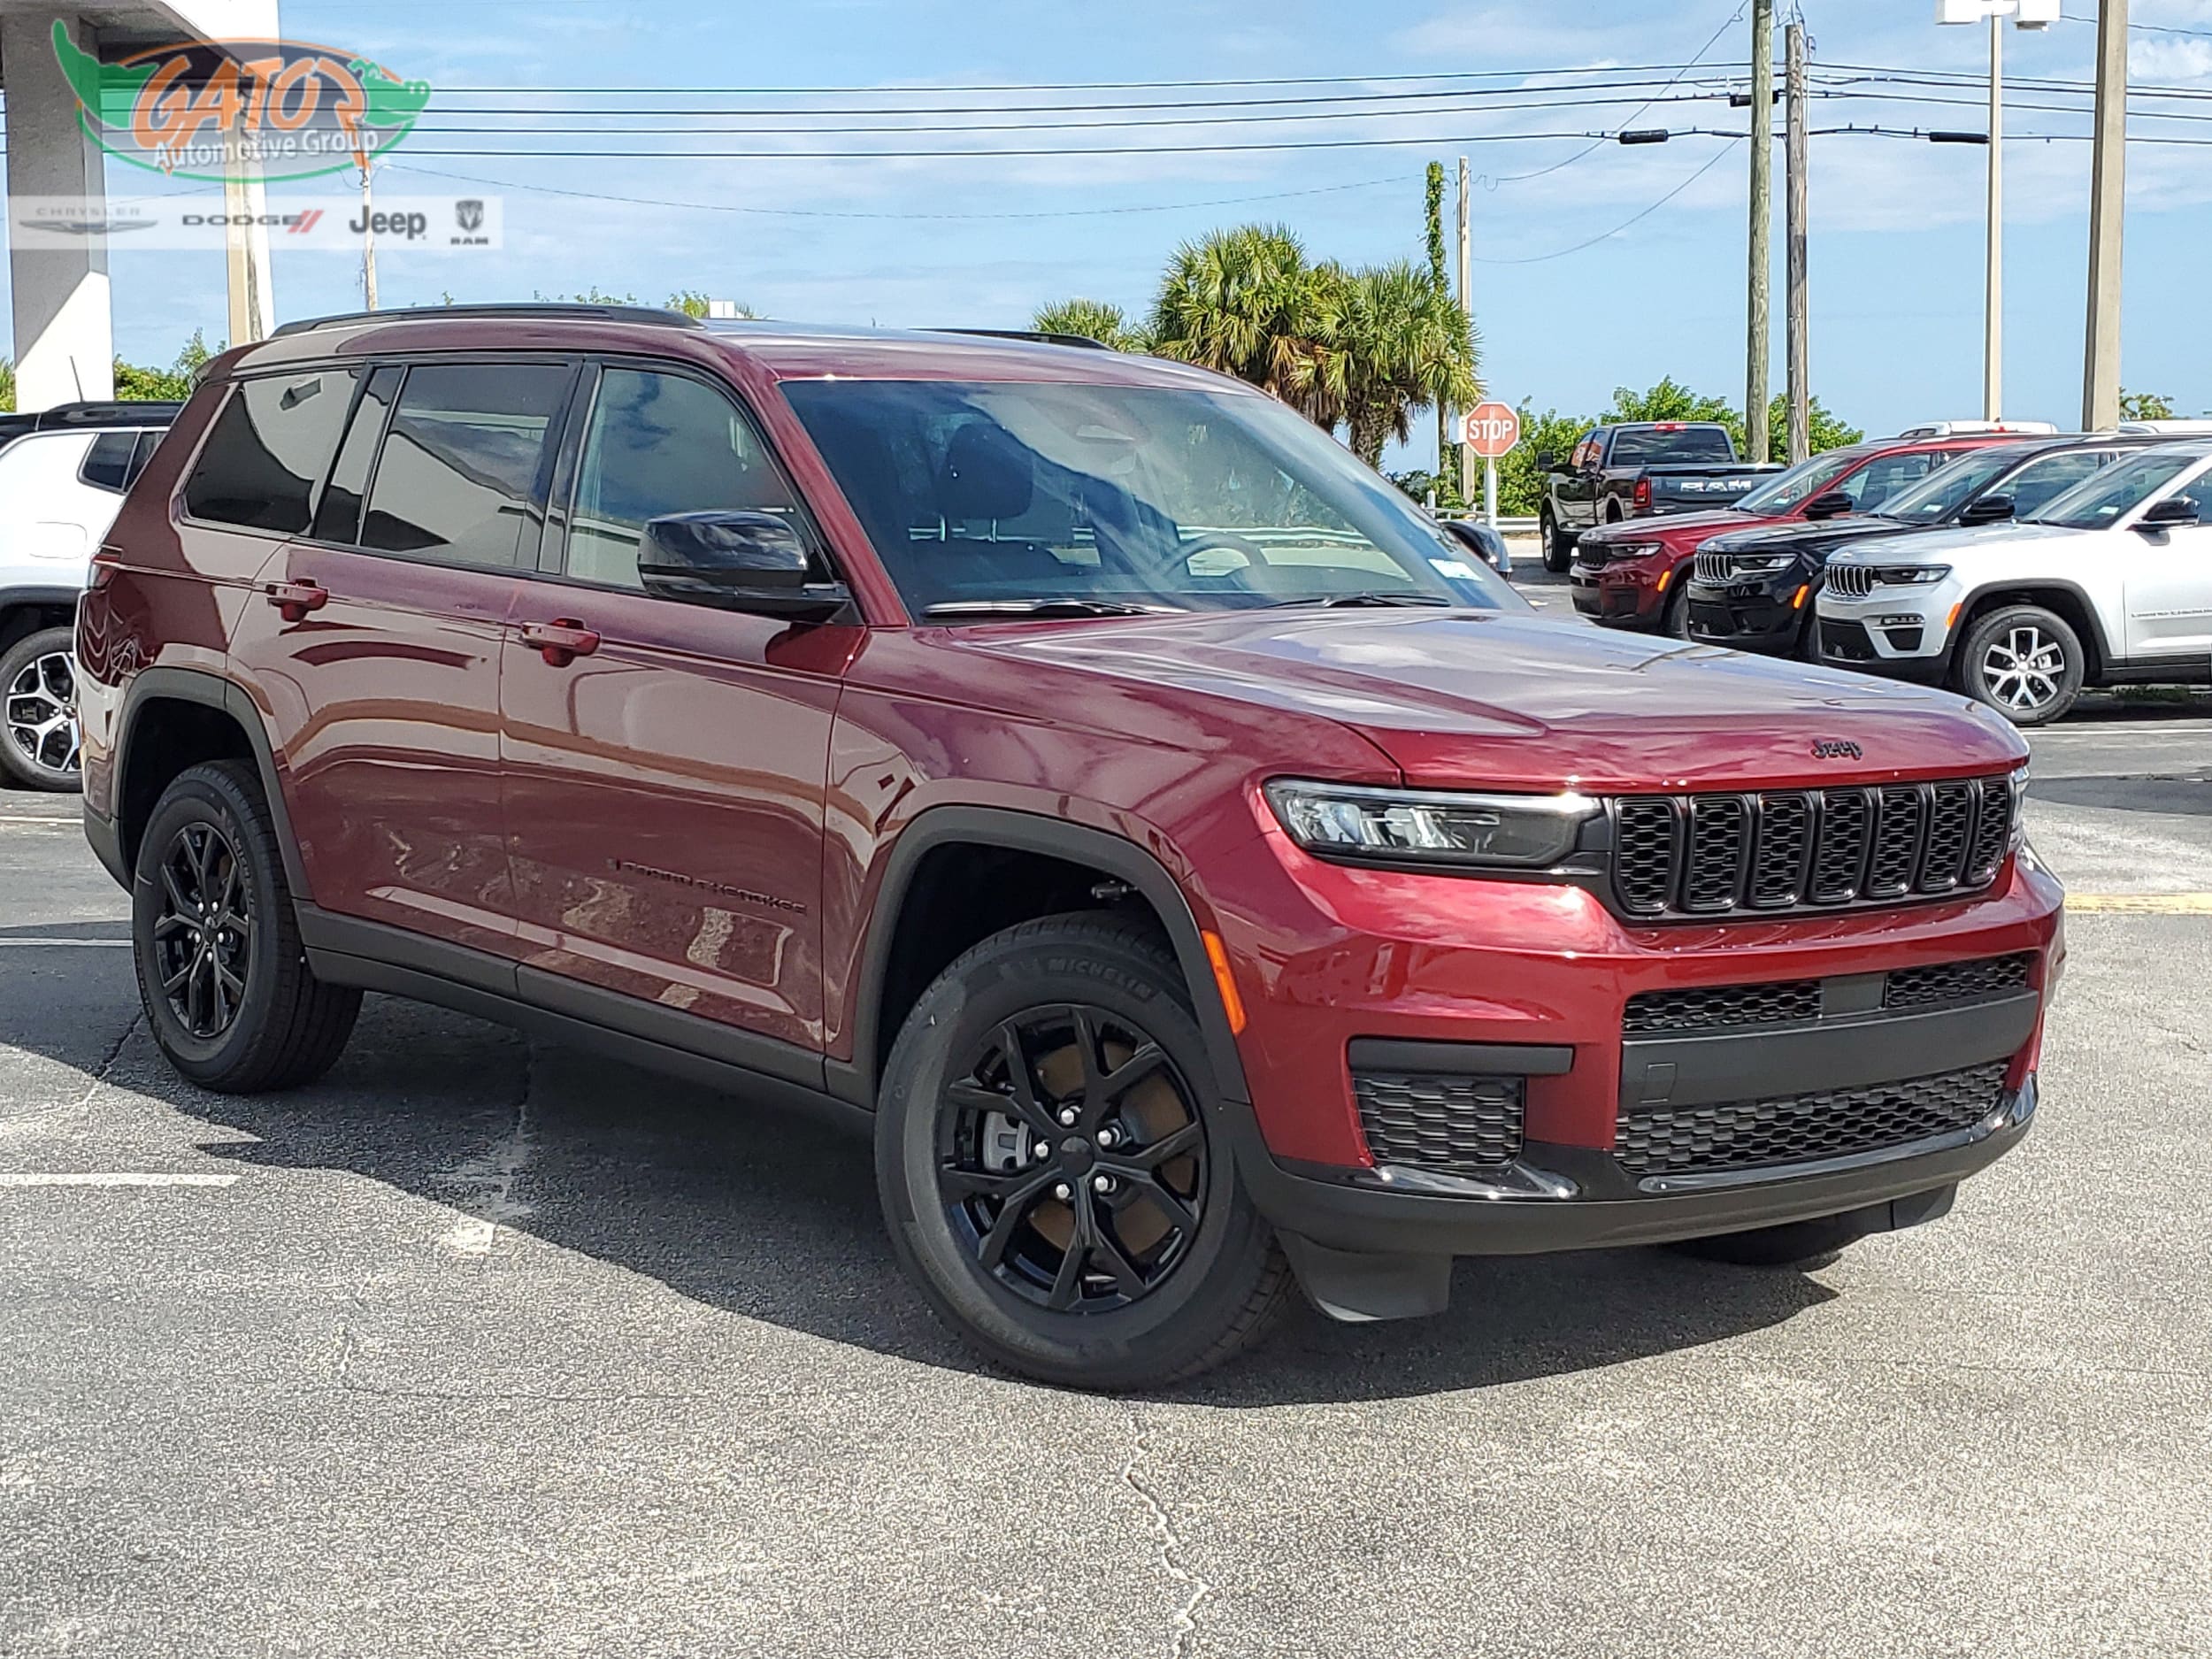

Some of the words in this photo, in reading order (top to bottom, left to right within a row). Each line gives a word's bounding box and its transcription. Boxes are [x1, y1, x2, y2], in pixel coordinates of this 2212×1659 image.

[1469, 419, 1514, 440] STOP
[1680, 480, 1753, 492] RAM
[1810, 739, 1863, 760] Jeep
[1047, 956, 1152, 1000] MICHELIN
